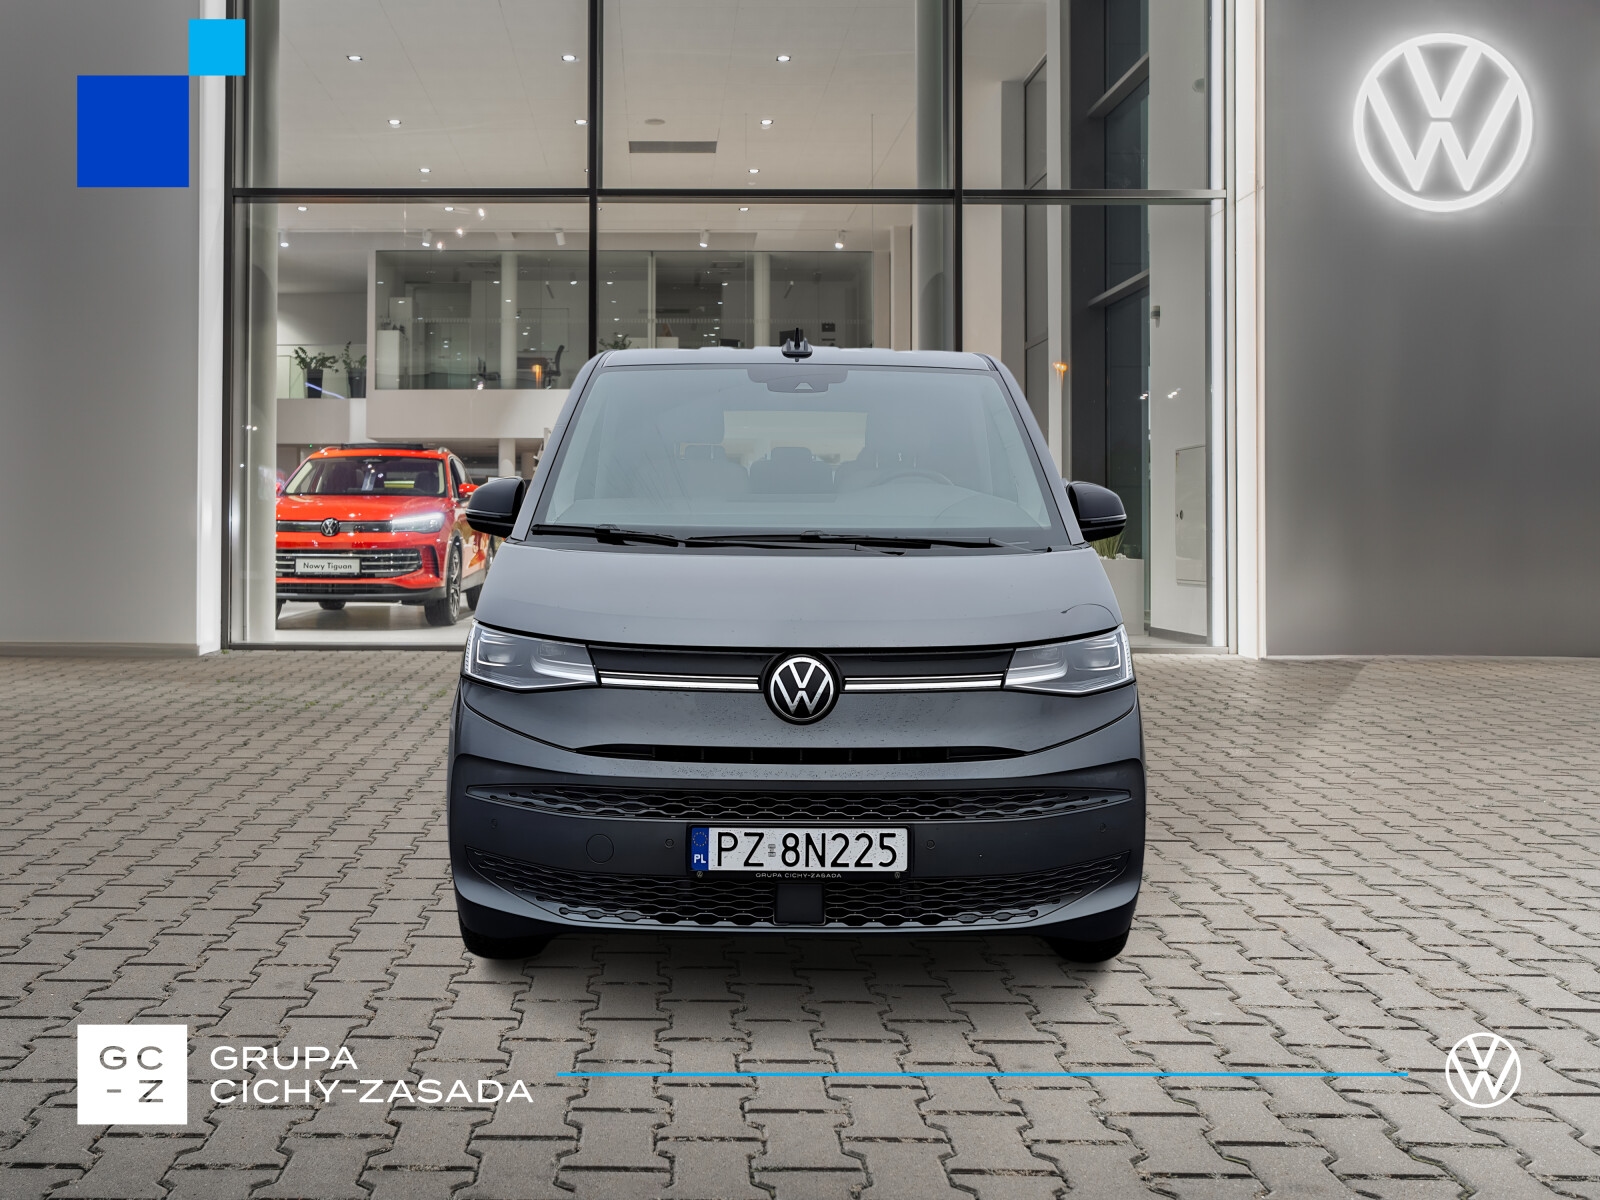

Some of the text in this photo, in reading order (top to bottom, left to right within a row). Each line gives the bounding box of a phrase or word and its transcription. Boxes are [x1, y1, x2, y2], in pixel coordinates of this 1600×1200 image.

[303, 562, 353, 571] Nowy Tiguan
[717, 832, 897, 867] PZ 8N225
[693, 853, 707, 864] PL
